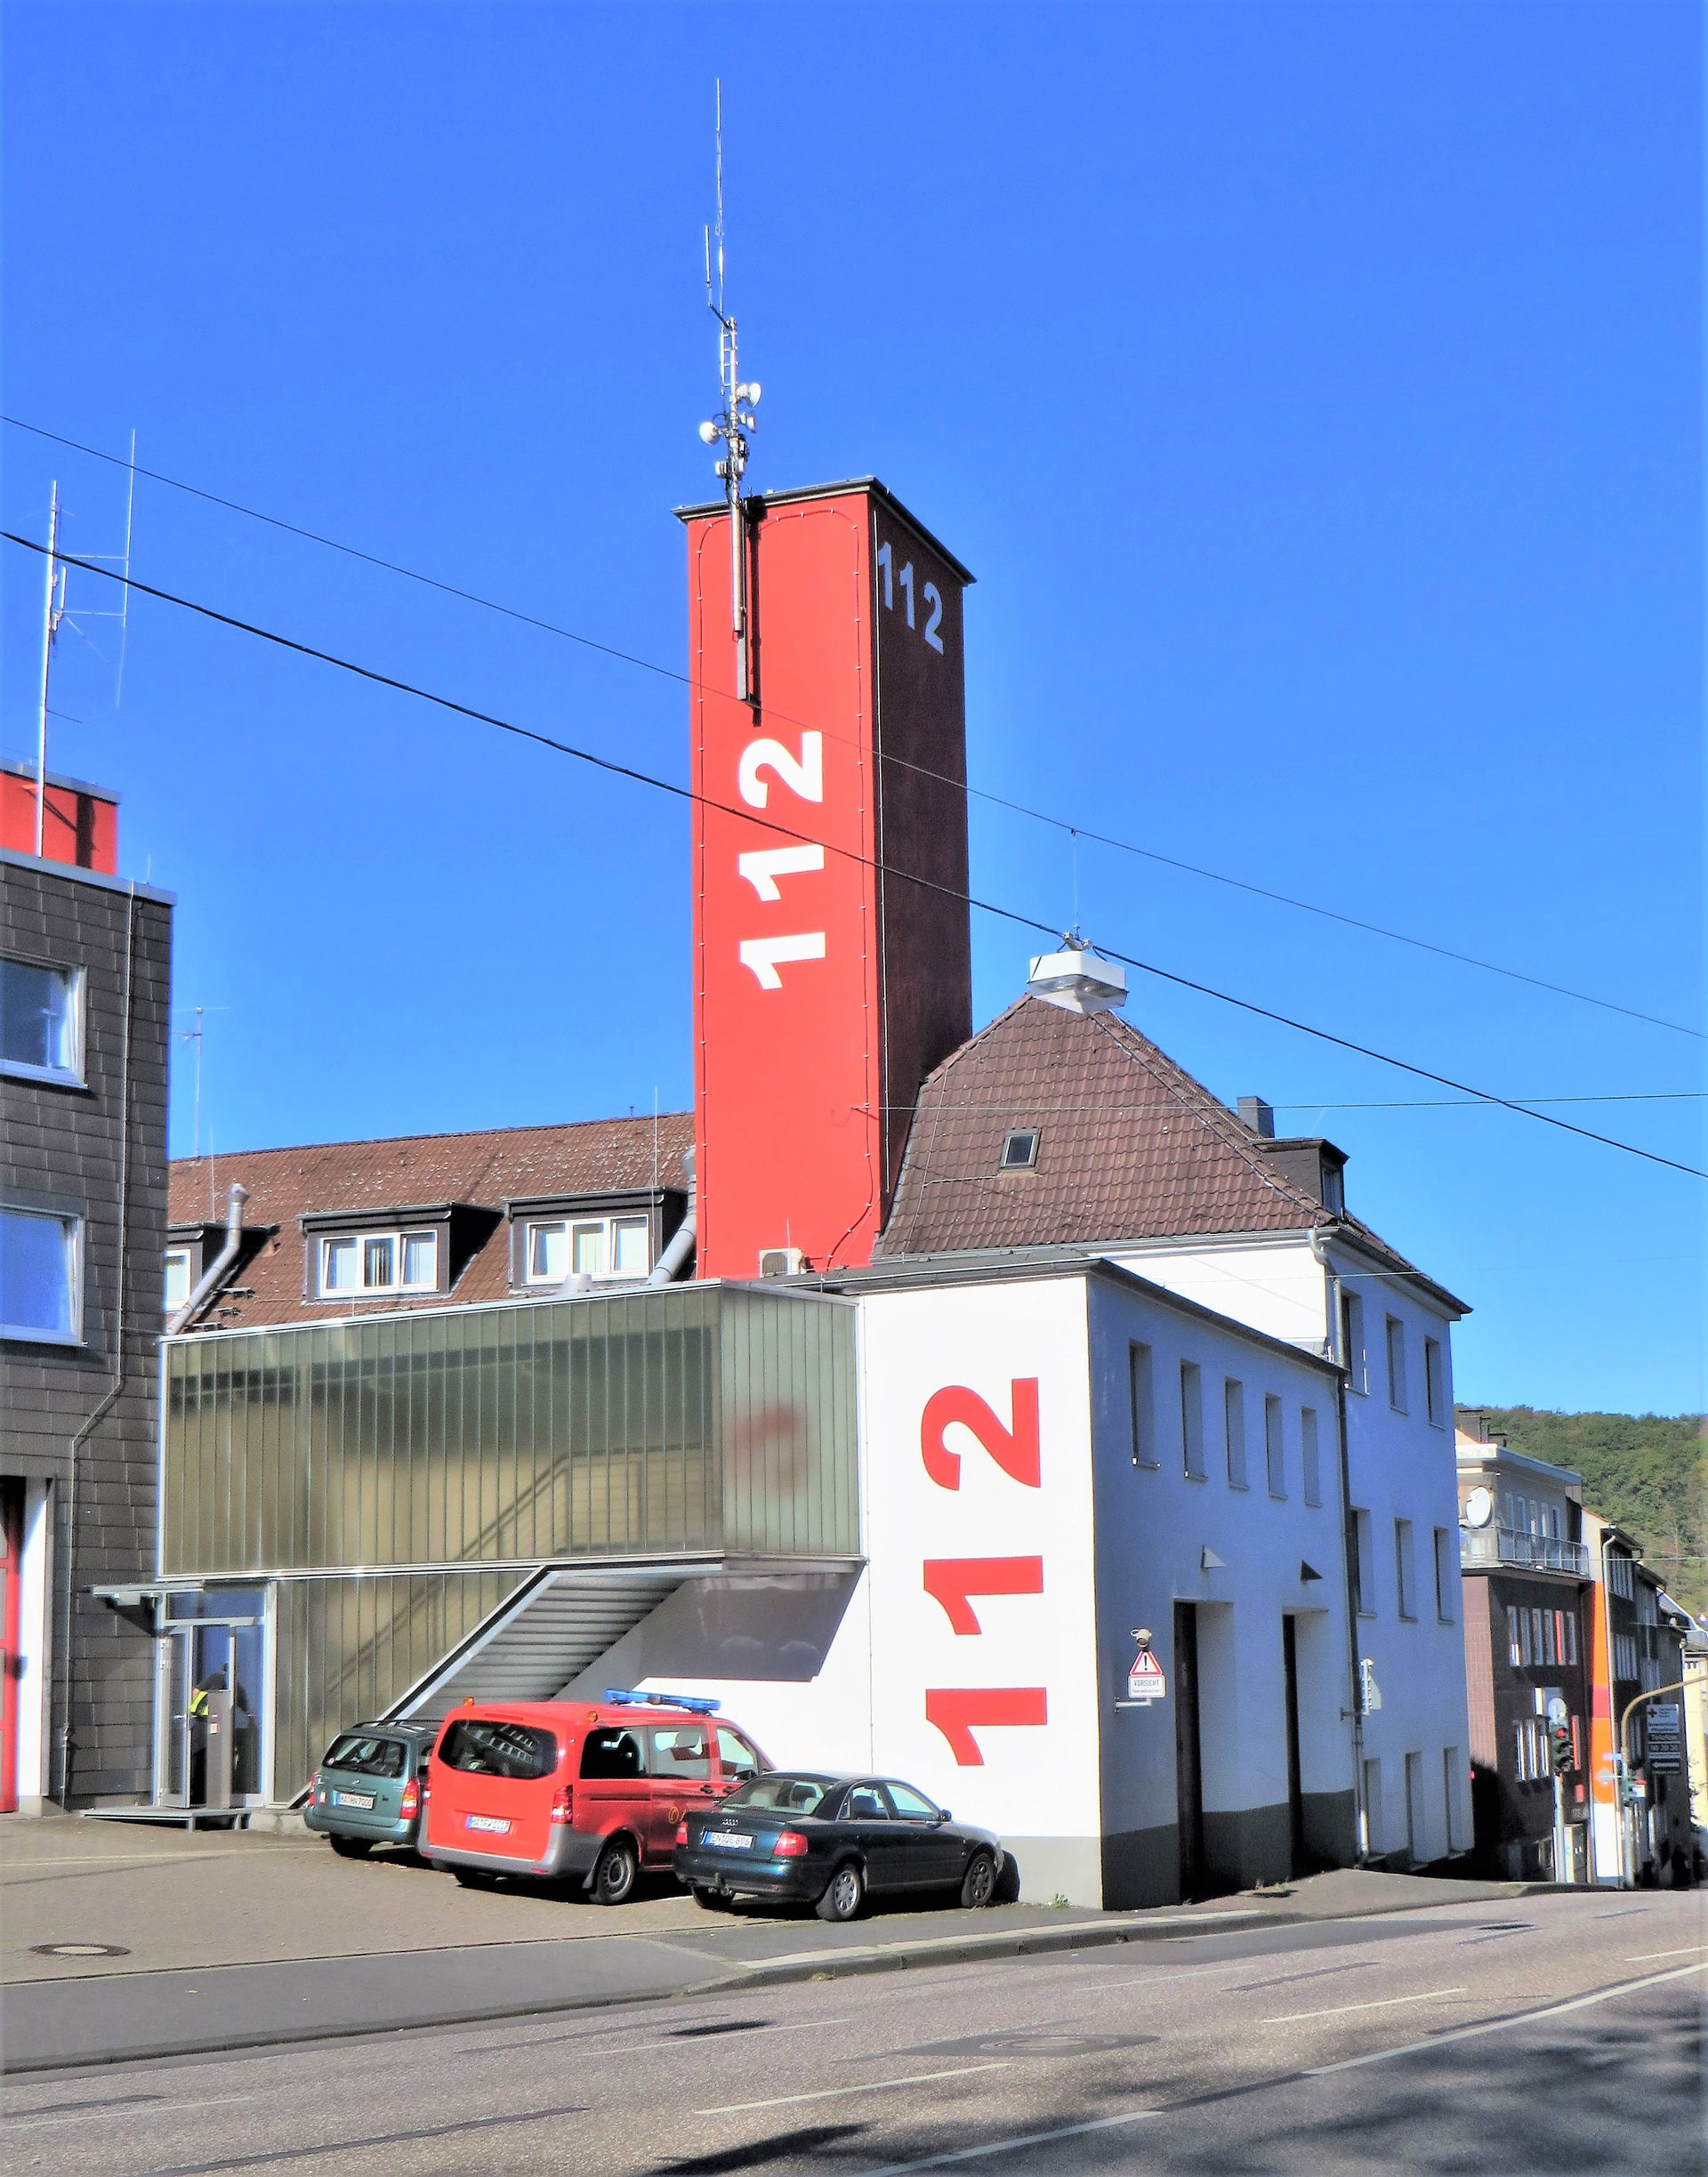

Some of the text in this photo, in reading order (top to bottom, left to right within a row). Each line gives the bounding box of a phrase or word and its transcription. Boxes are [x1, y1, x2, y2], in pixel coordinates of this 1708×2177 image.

[878, 541, 944, 656] 112
[738, 730, 826, 990] 112
[921, 1377, 1048, 1766] 112
